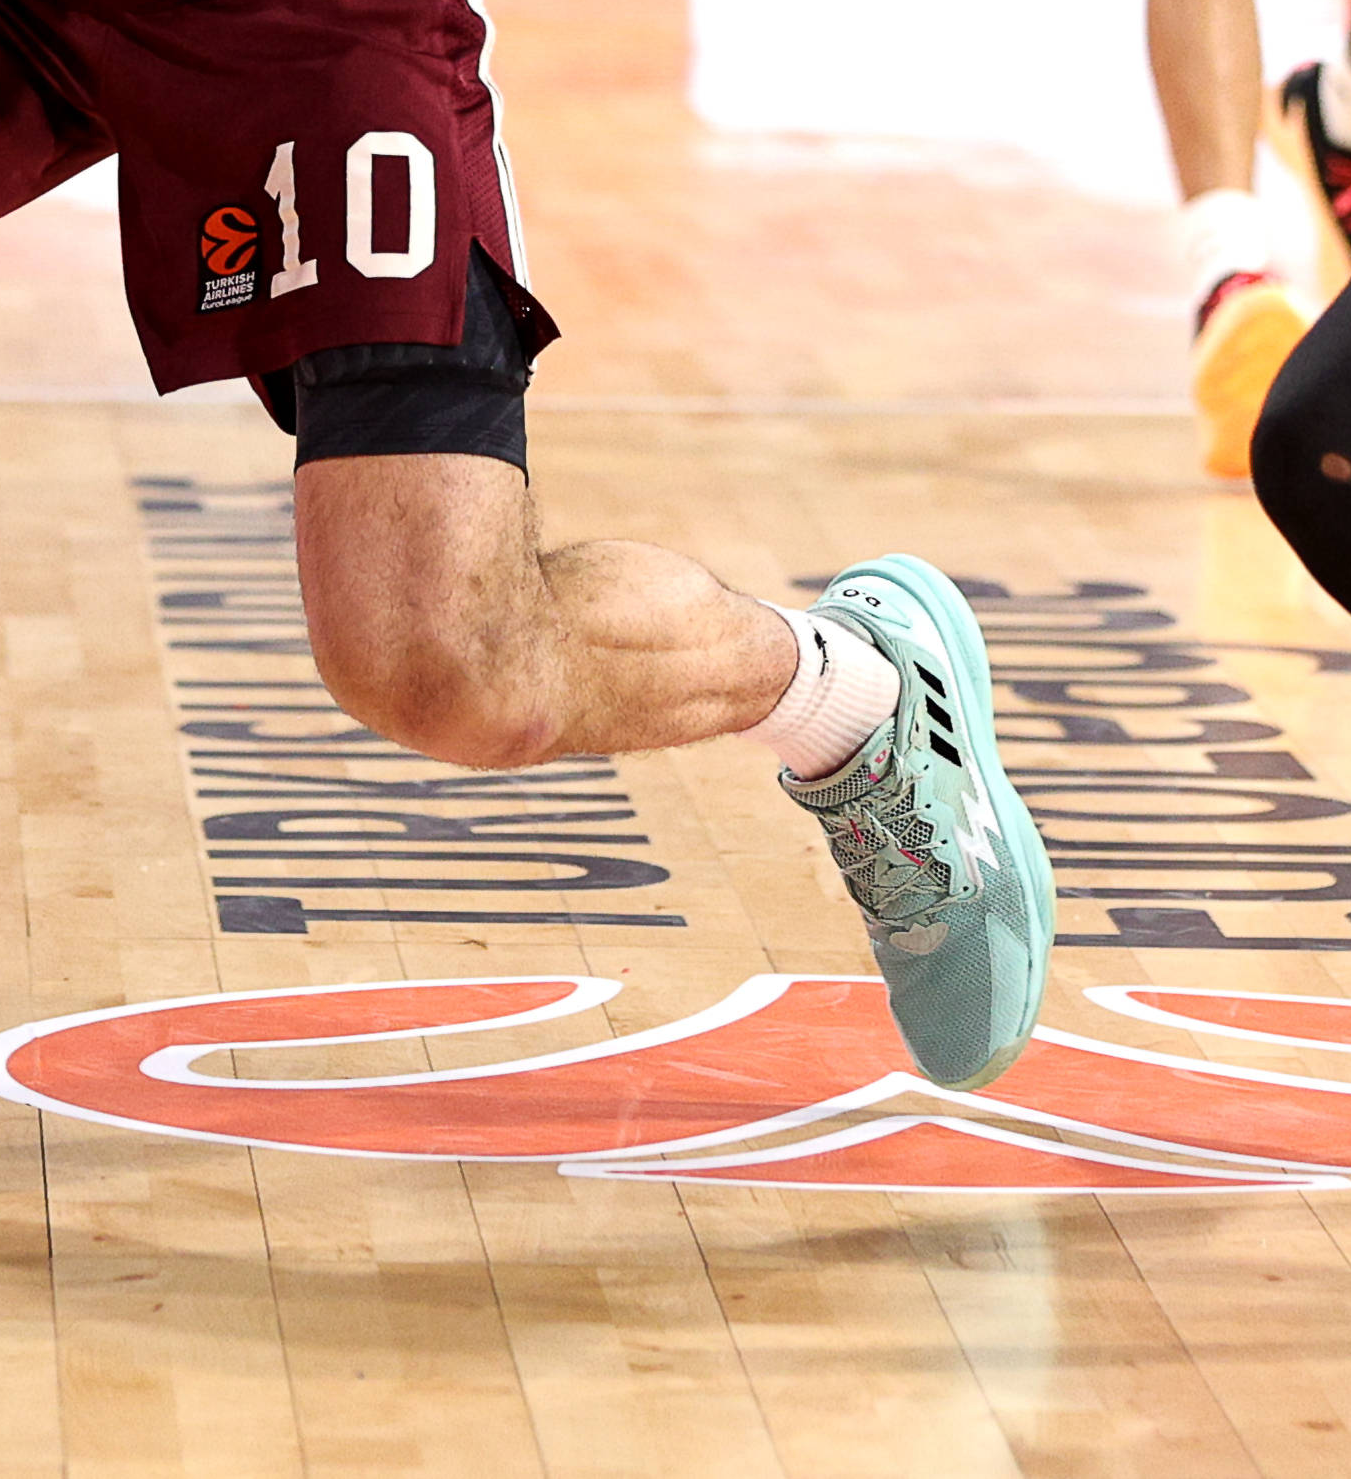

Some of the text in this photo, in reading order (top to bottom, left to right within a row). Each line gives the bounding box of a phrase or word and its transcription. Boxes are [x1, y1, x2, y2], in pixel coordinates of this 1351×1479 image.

[264, 131, 436, 299] 10
[205, 271, 256, 291] TURKISH
[203, 282, 254, 302] AIRLINES
